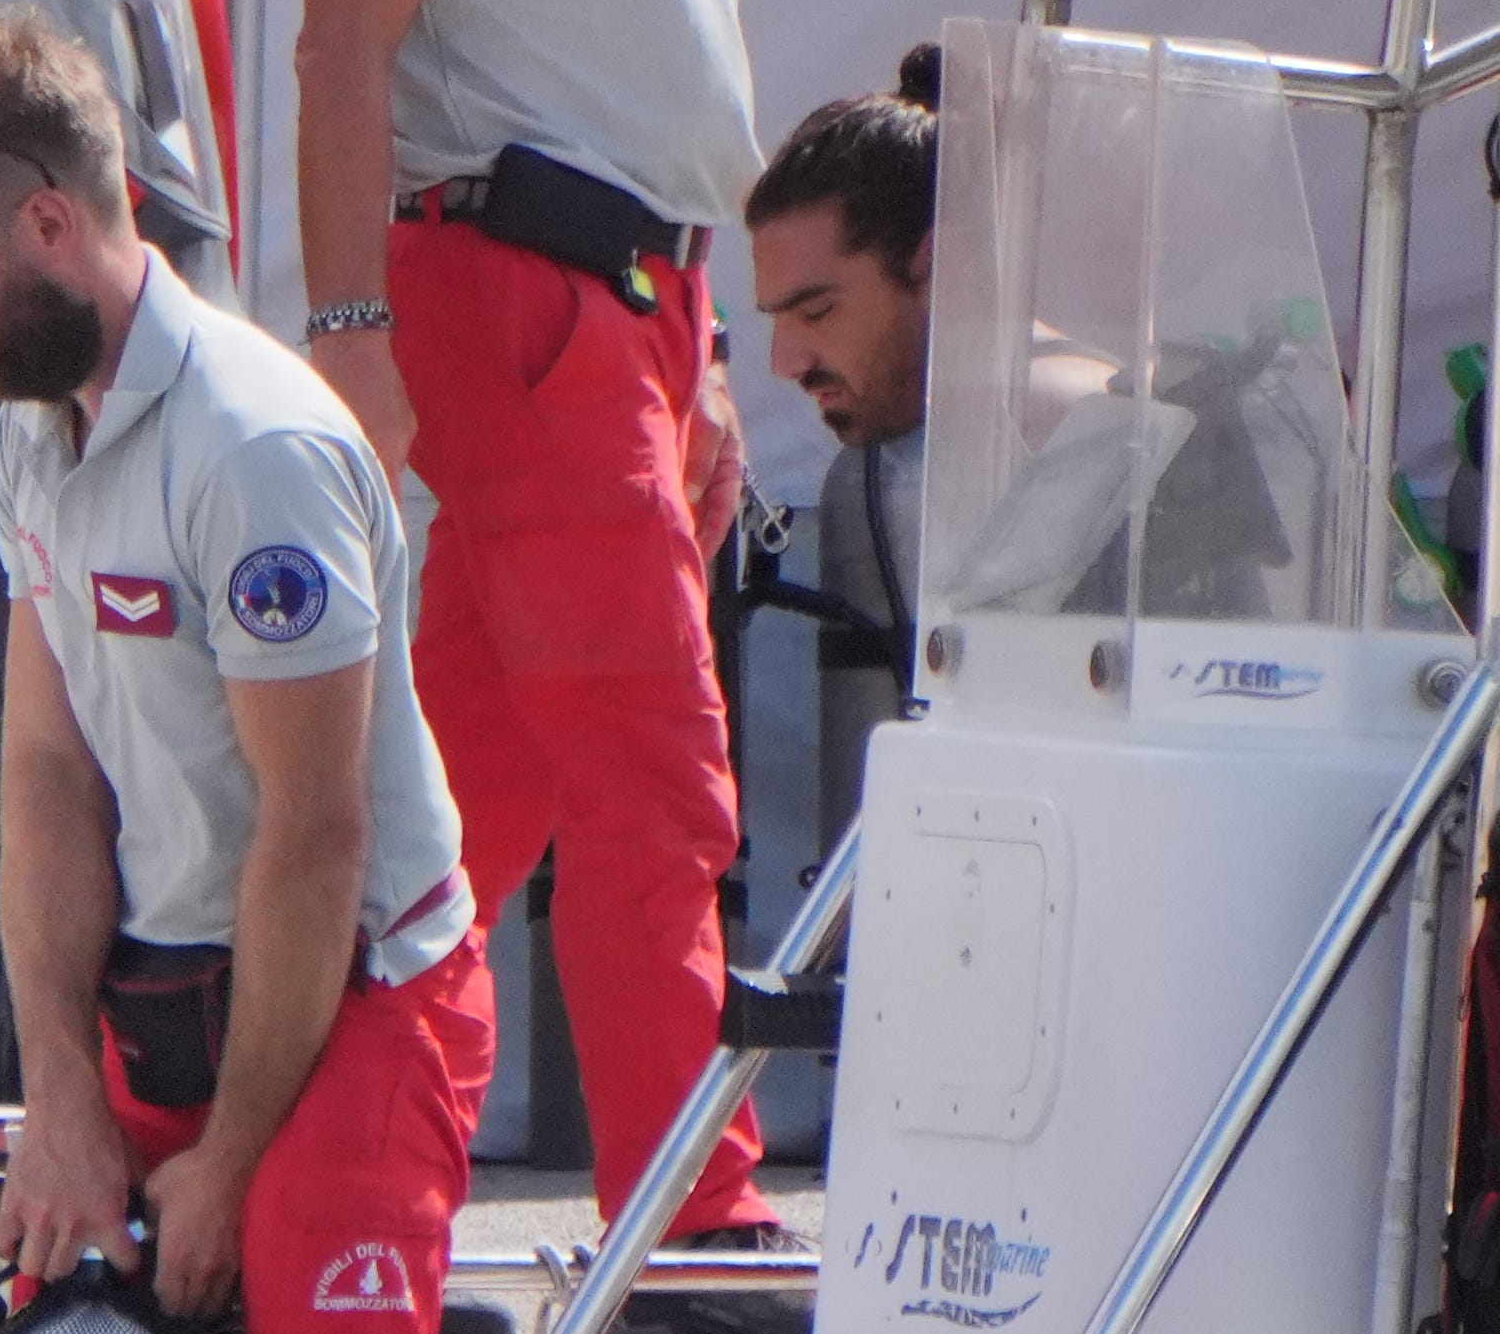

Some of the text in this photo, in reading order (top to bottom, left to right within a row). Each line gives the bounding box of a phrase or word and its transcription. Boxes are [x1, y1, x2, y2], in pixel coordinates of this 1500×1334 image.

[315, 1250, 353, 1298] VIGILI
[355, 1243, 385, 1259] DEL
[885, 1213, 996, 1297] STEM
